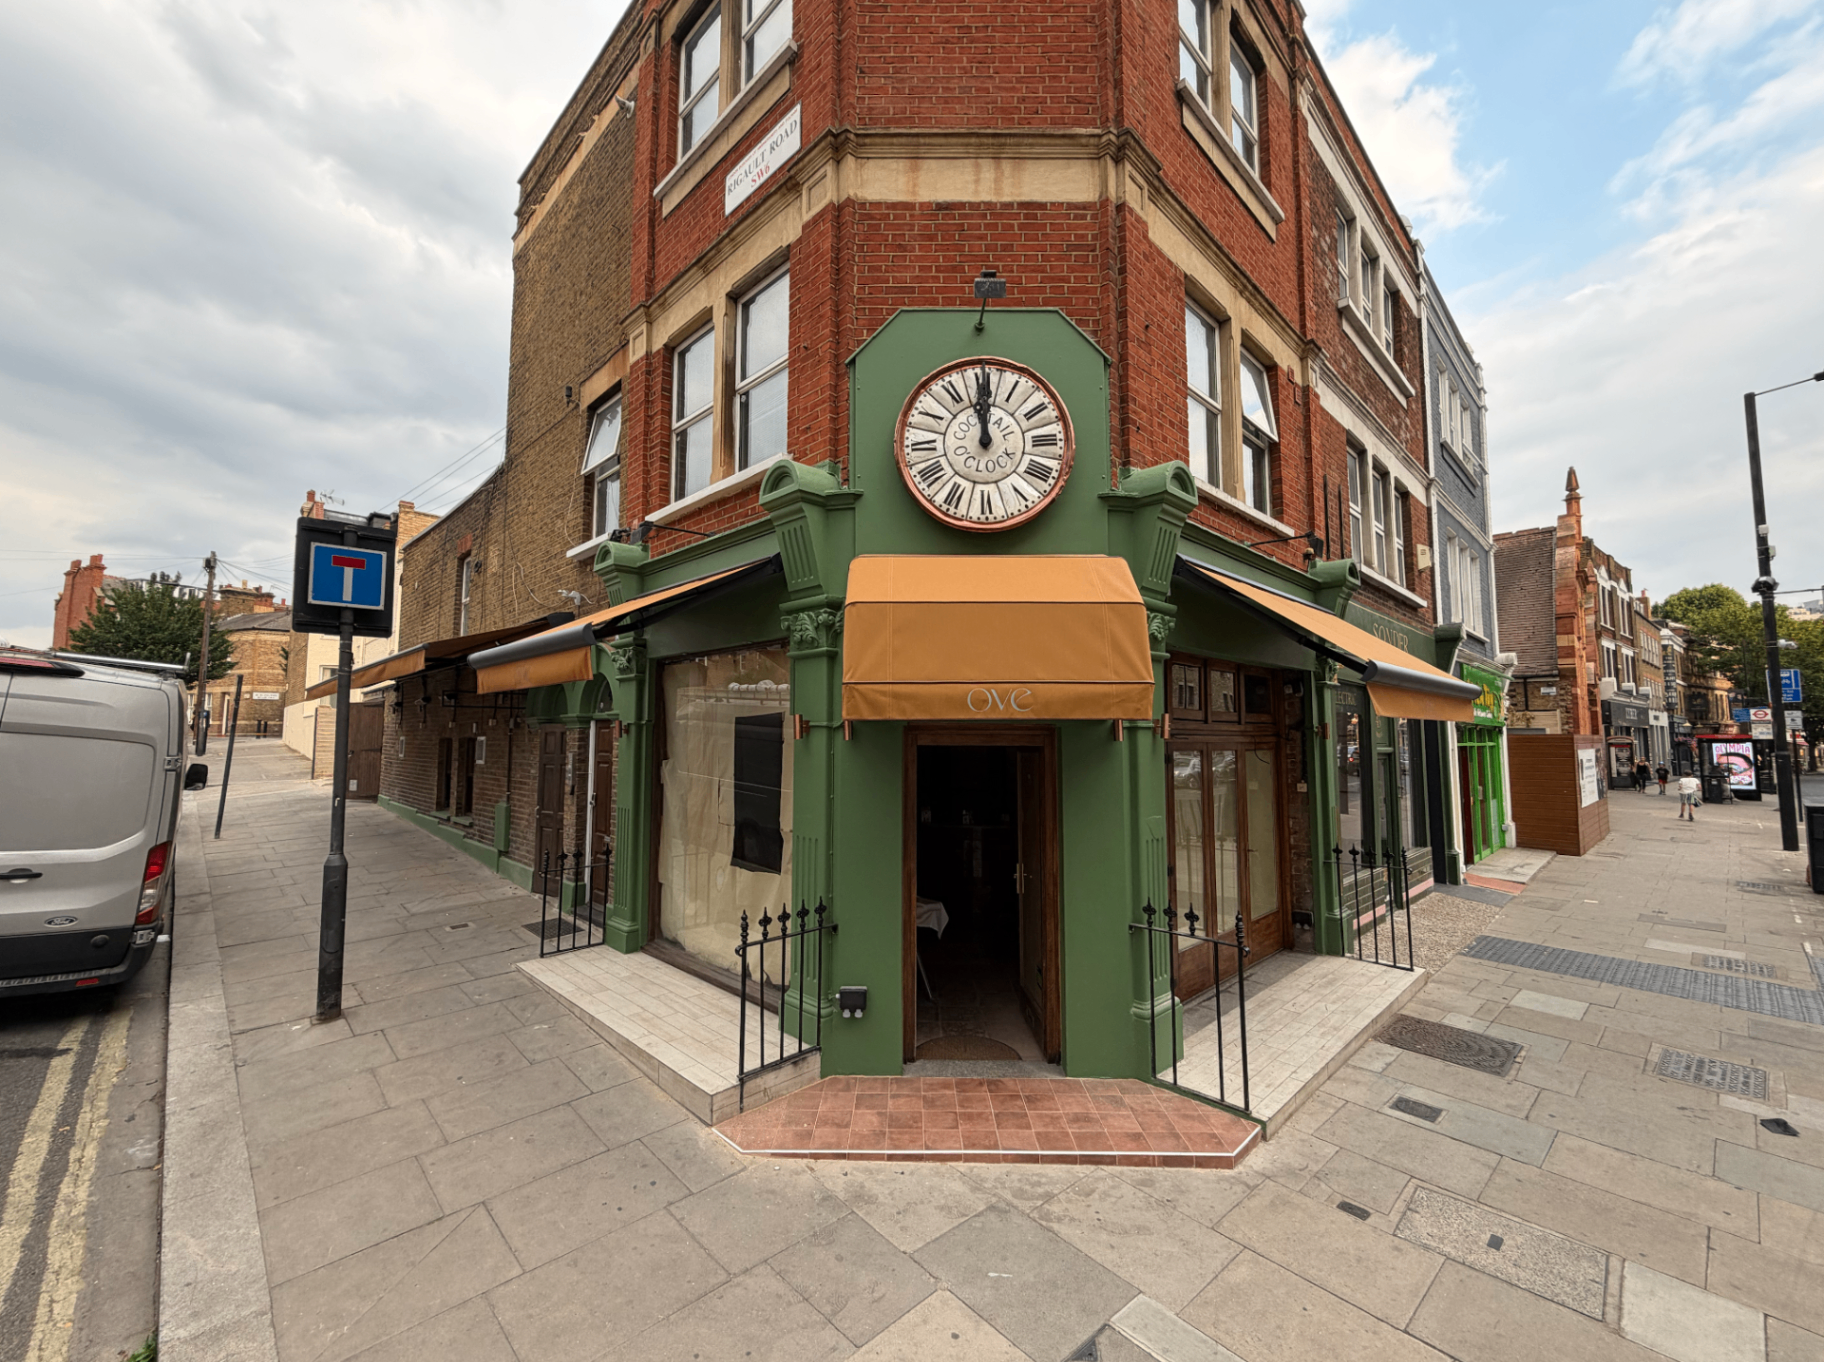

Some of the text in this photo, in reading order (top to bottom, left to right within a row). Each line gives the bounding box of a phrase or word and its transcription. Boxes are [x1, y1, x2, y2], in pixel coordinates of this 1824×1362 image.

[727, 149, 767, 196] RIGAULT
[769, 119, 798, 155] ROAD
[751, 160, 770, 188] SW6
[953, 412, 1015, 442] COCTAIL
[953, 445, 1016, 473] O'CLOCK
[1373, 623, 1409, 654] SONDER
